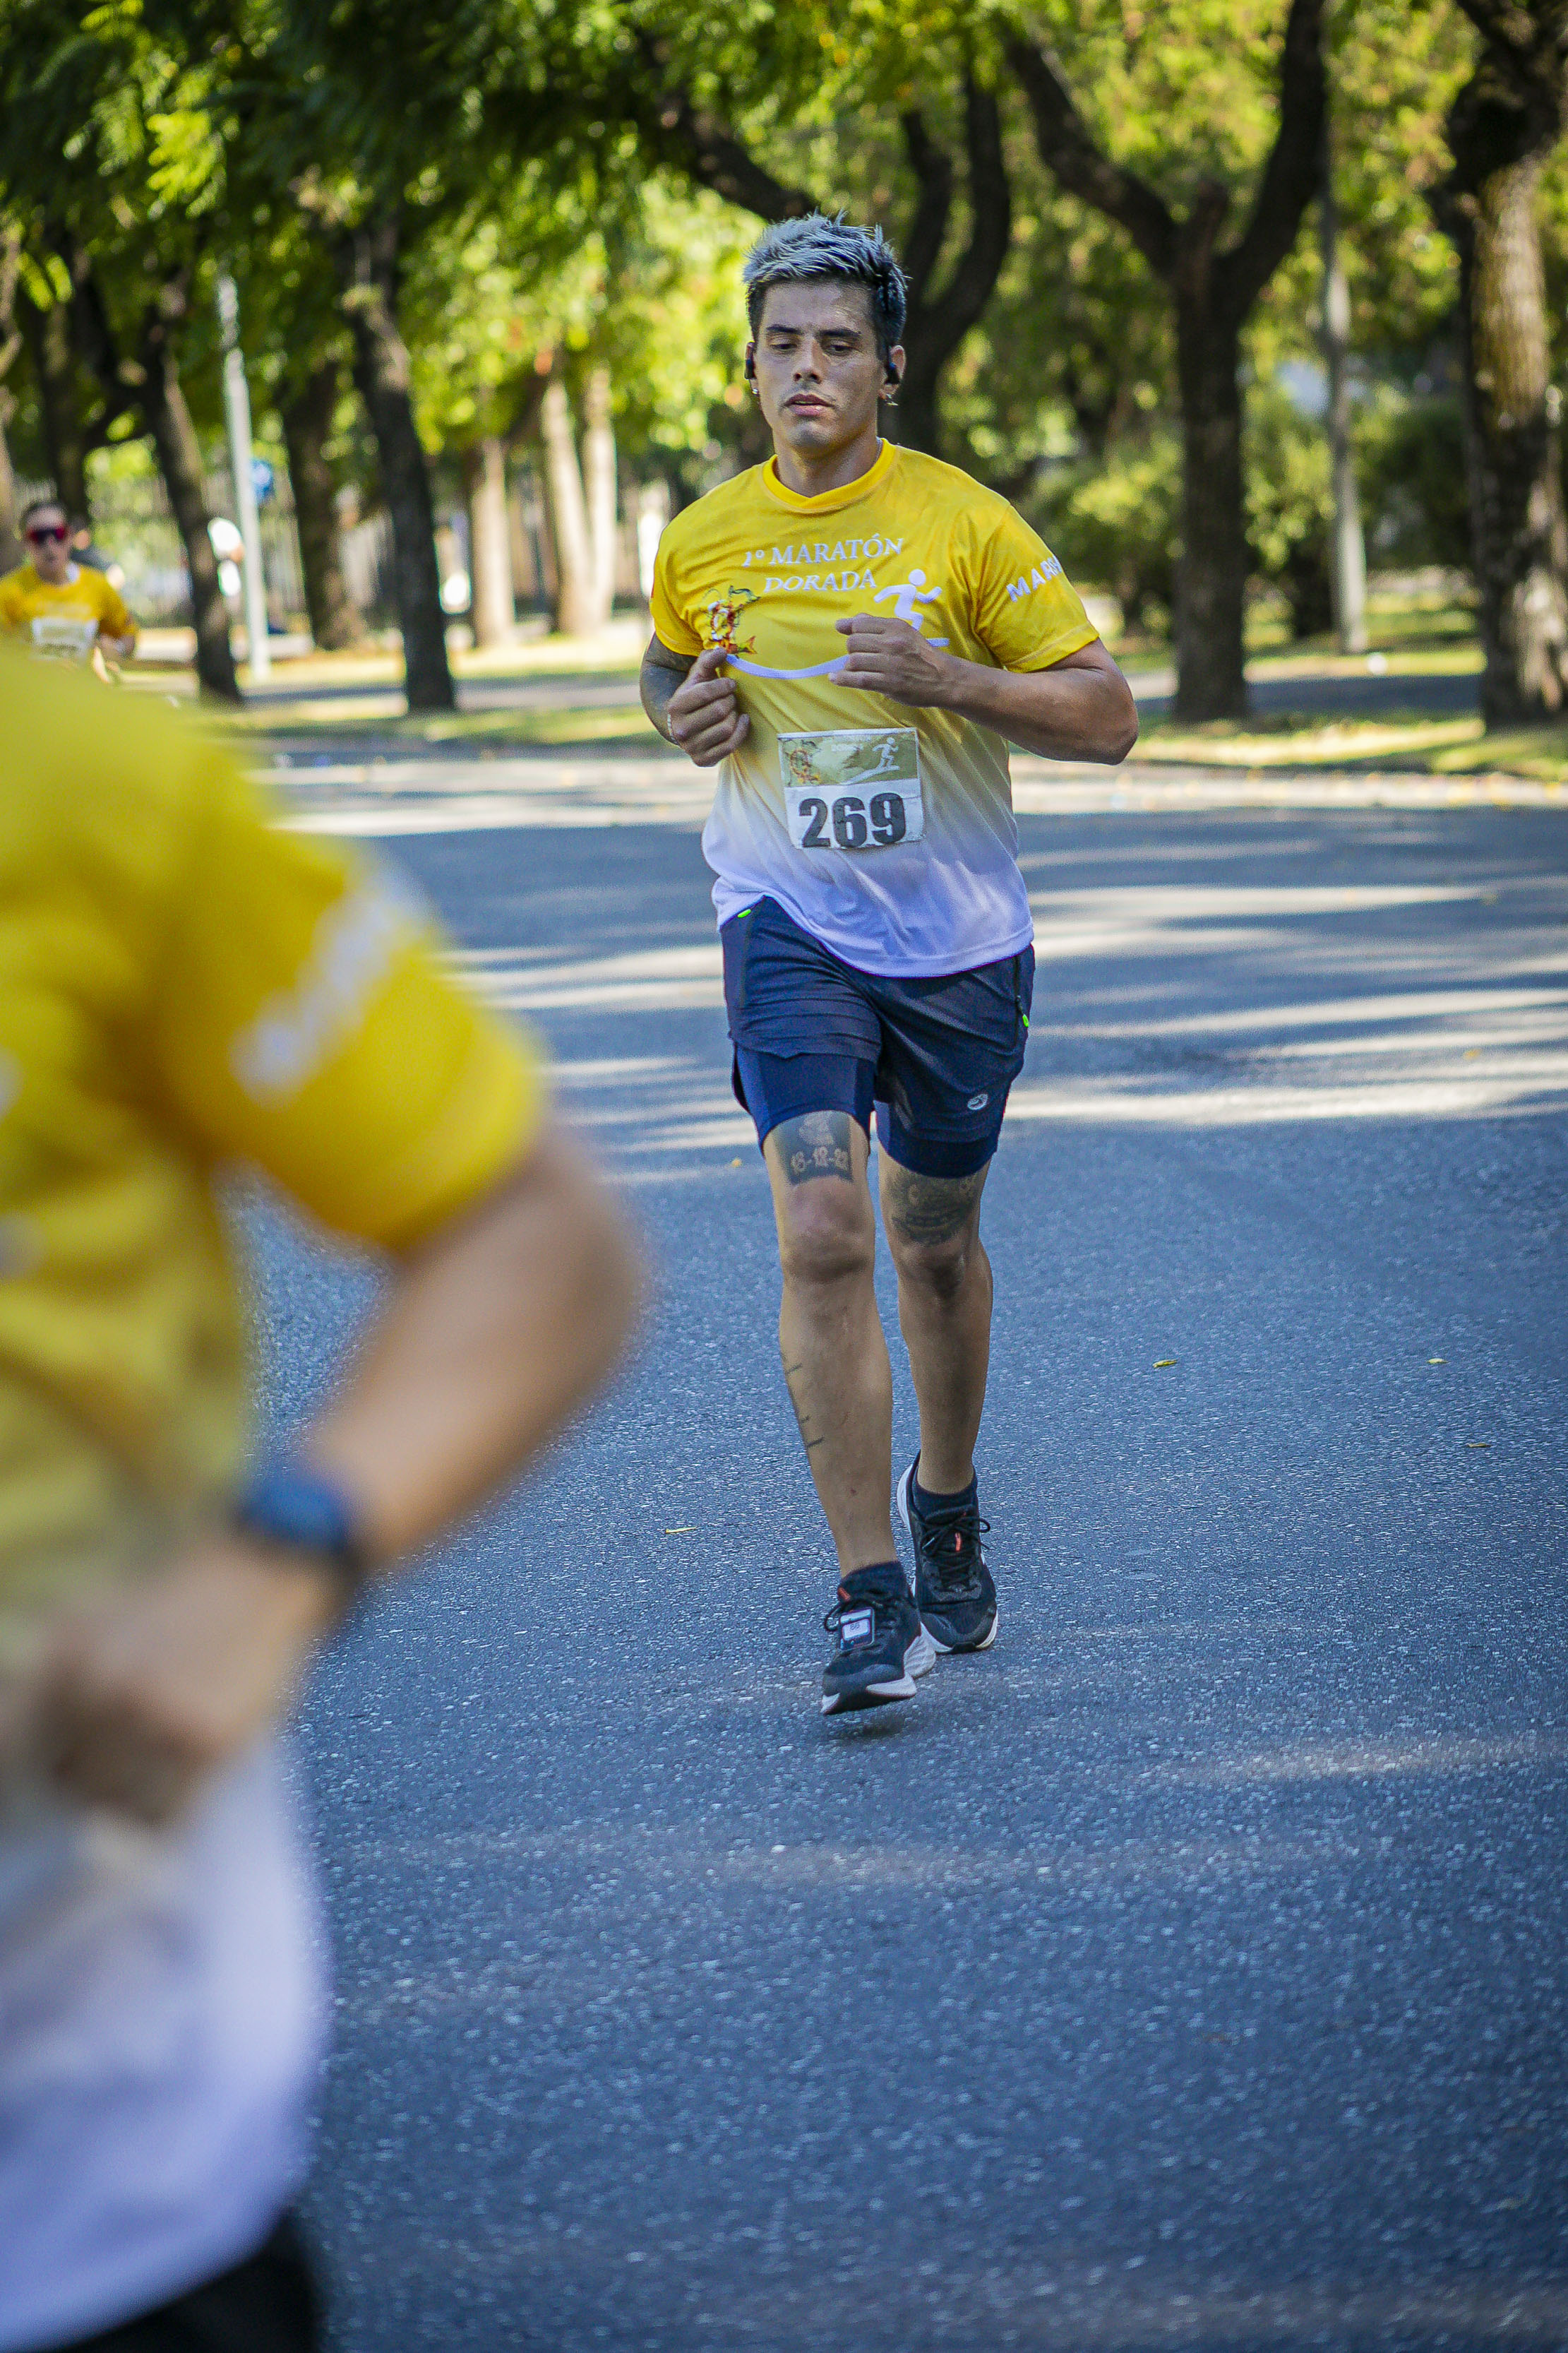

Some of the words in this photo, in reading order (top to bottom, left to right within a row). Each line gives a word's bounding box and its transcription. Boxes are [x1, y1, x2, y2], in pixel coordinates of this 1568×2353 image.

[769, 532, 904, 566] MARATÓN
[763, 568, 877, 593] DORADA
[798, 792, 906, 848] 269
